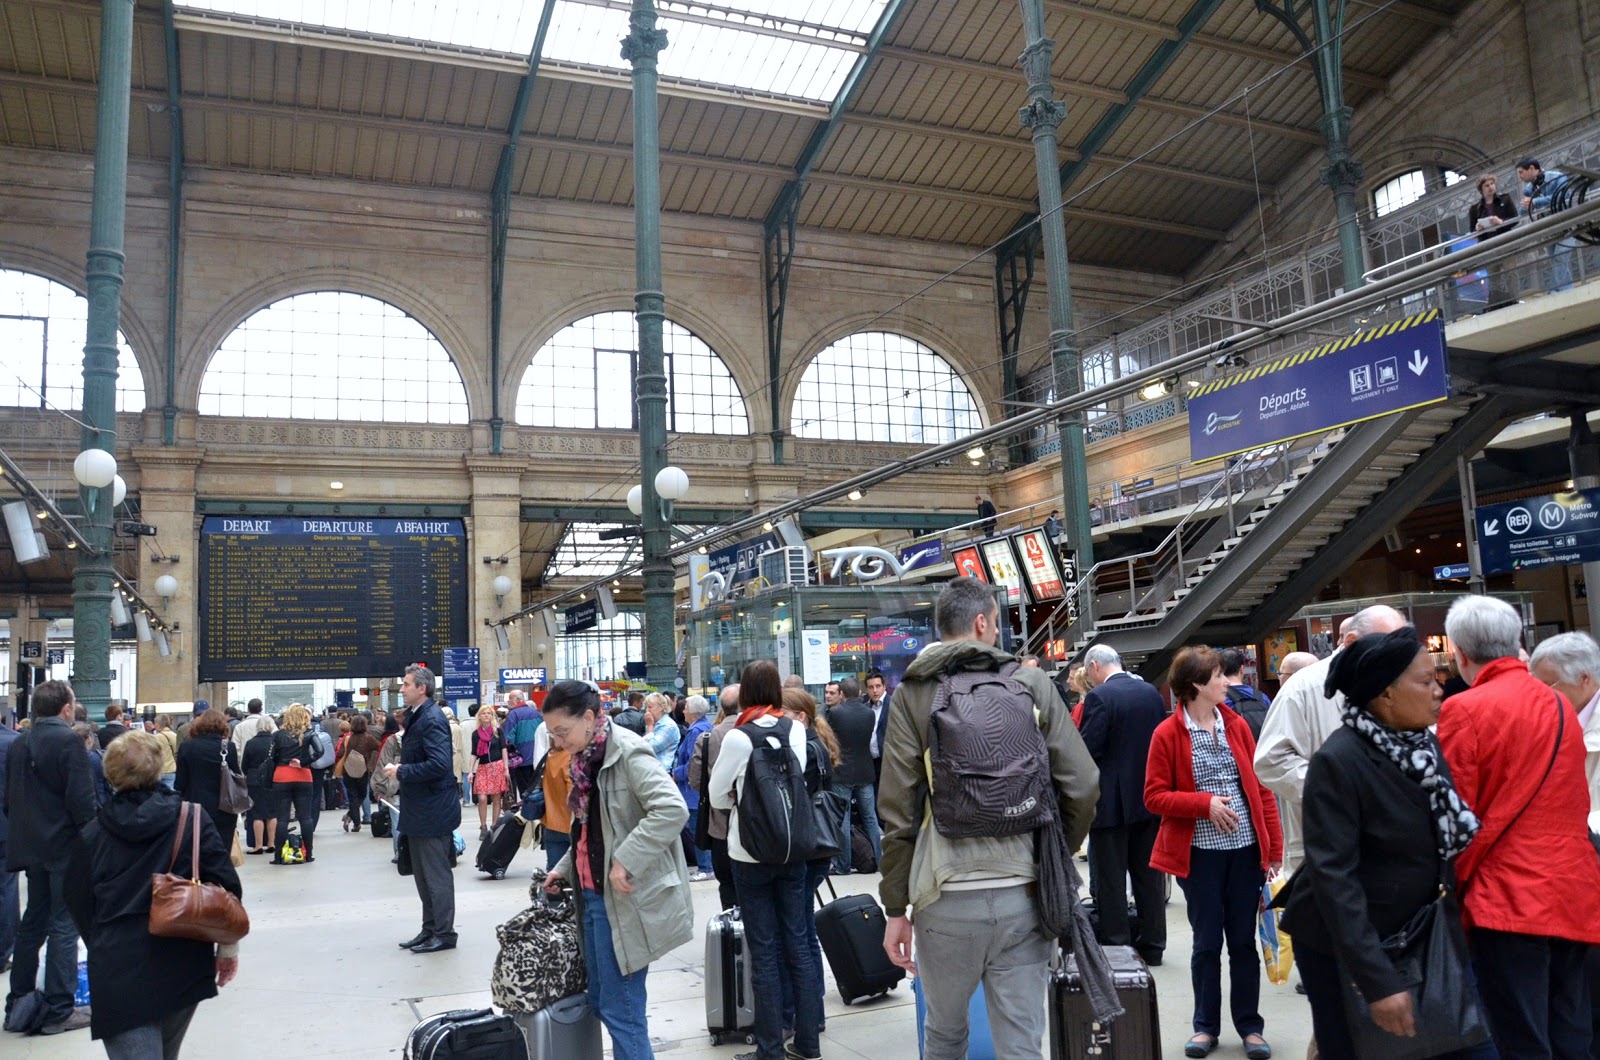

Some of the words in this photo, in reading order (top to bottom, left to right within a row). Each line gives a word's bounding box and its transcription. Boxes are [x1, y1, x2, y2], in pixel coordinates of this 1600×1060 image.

[1259, 387, 1307, 411] Départs
[1351, 389, 1381, 403] UNIQUEMENT
[1218, 420, 1241, 431] EUROSTAR
[1509, 514, 1529, 527] RER
[1544, 507, 1560, 524] M
[1570, 511, 1598, 521] Subway
[223, 520, 271, 532] DEPART
[303, 521, 373, 533] DEPARTURE
[395, 521, 450, 533] ABFAHRT
[821, 546, 929, 580] TGV
[1062, 553, 1076, 579] Tie
[1520, 558, 1540, 566] Agence
[26, 647, 39, 657] 15
[1046, 640, 1065, 657] RLAY
[51, 655, 62, 664] 16
[503, 669, 545, 679] CHANGE
